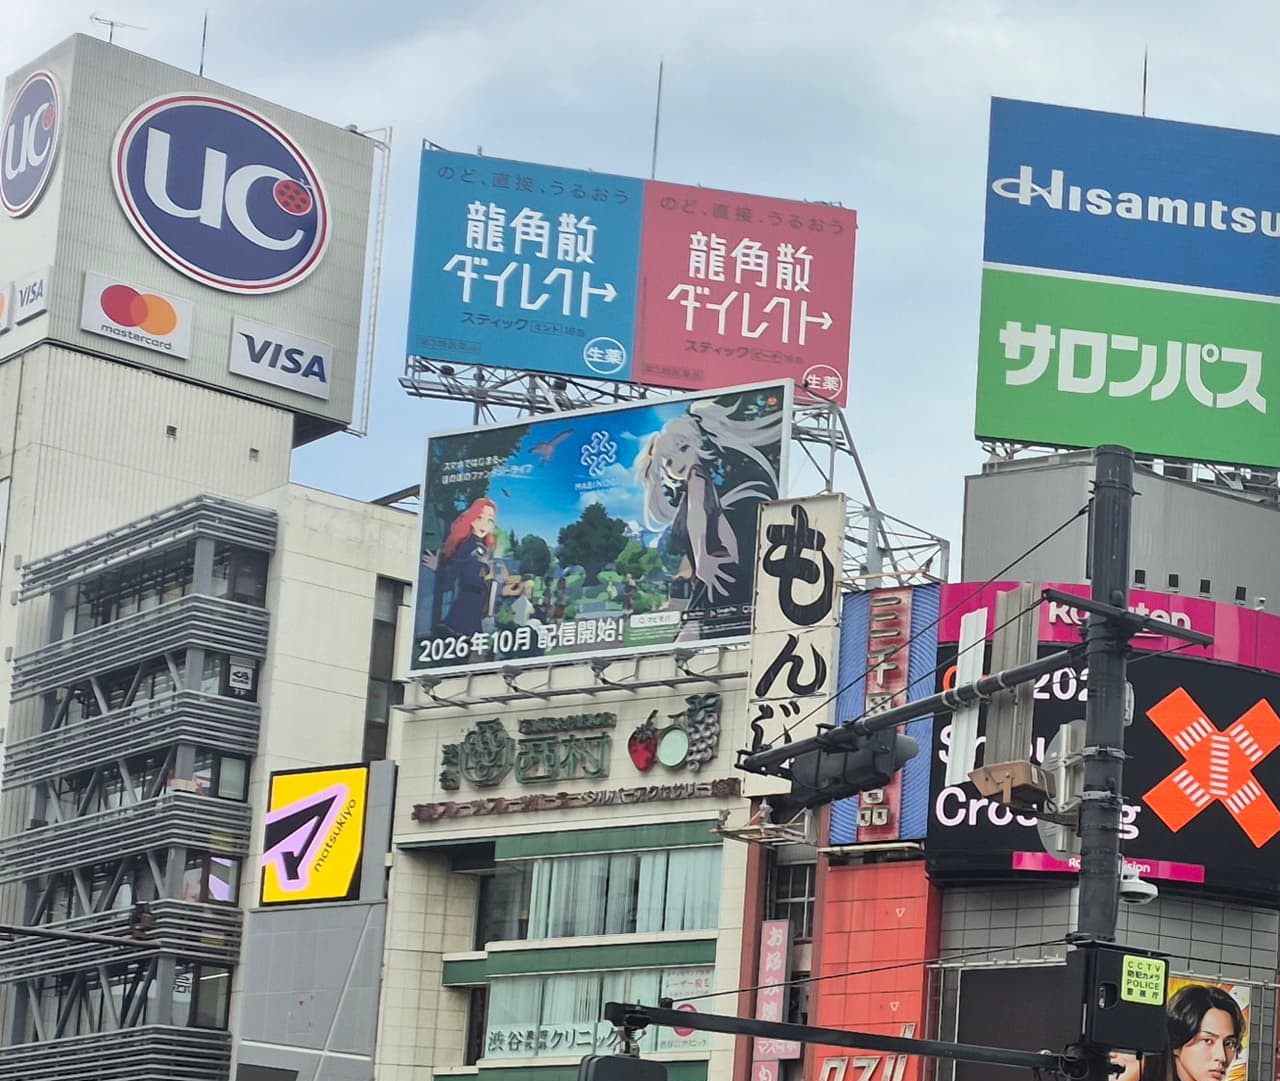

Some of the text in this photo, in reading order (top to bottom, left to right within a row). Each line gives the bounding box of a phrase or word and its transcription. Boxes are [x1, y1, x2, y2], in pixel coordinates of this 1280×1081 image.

[145, 127, 304, 250] UC
[437, 164, 630, 206] のど、直接、うるおう
[466, 201, 597, 265] 龍角散
[661, 195, 844, 235] のど、直接、うるおう
[689, 231, 813, 294] 龍角散
[18, 279, 44, 308] VISA
[101, 323, 172, 352] mastercard
[461, 311, 528, 333] スティック
[240, 332, 327, 383] VISA
[686, 339, 749, 360] スティック
[999, 320, 1267, 414] サロンパス
[418, 628, 531, 663] 2026年10月
[751, 503, 835, 772] もんじ
[313, 798, 357, 873] matsukiyo
[1126, 979, 1160, 991] POLICE
